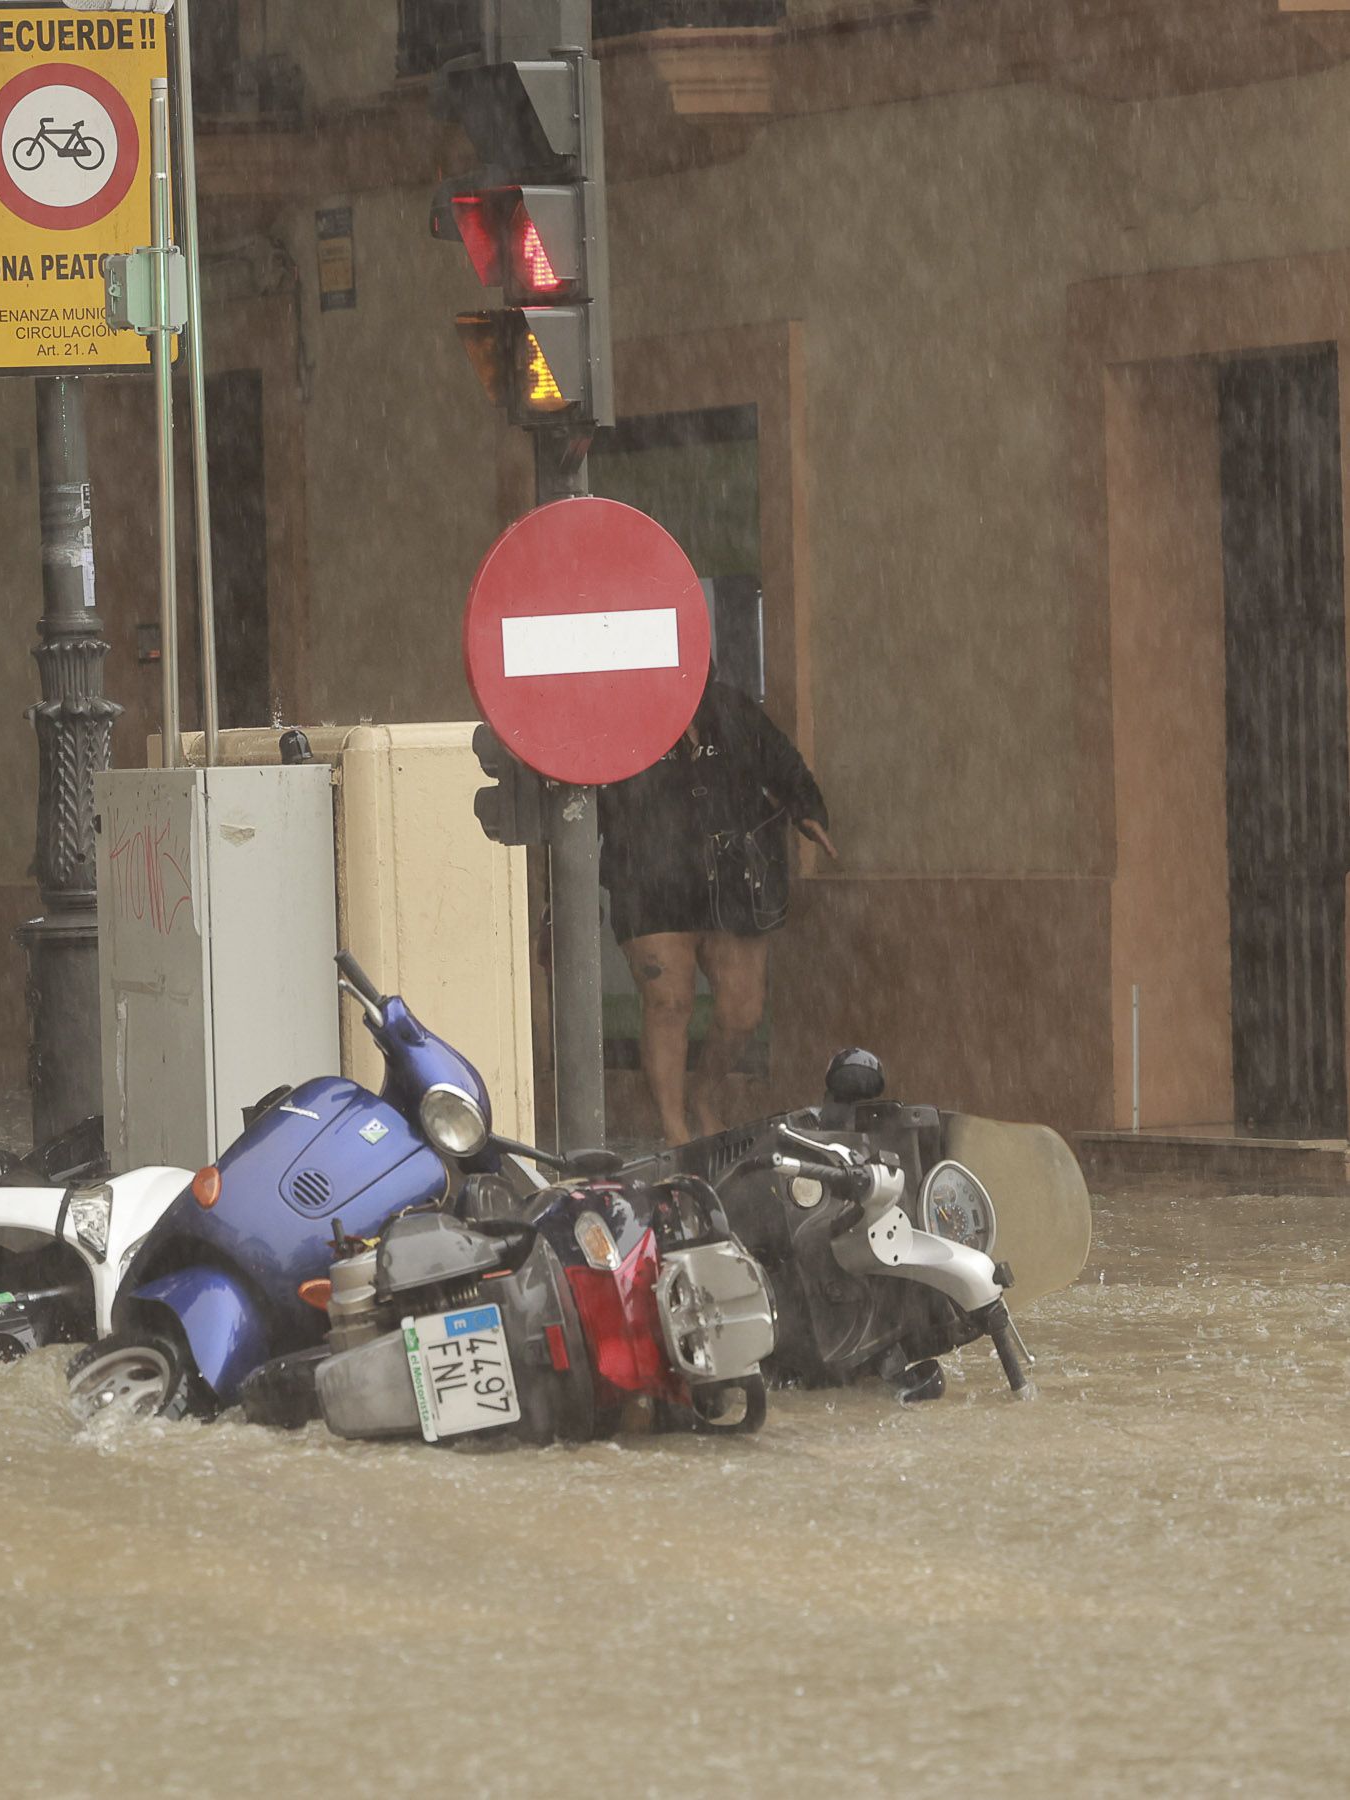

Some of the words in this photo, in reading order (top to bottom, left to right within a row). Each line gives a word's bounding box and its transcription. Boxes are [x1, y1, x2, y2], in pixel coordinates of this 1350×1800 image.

[41, 253, 106, 280] PEATO
[62, 307, 106, 321] MUNIC
[15, 322, 117, 340] CIRCULACIÓN
[37, 343, 59, 356] Art.
[88, 342, 98, 355] A
[453, 1318, 467, 1330] E
[428, 1341, 468, 1404] FNL
[466, 1338, 511, 1413] 4497
